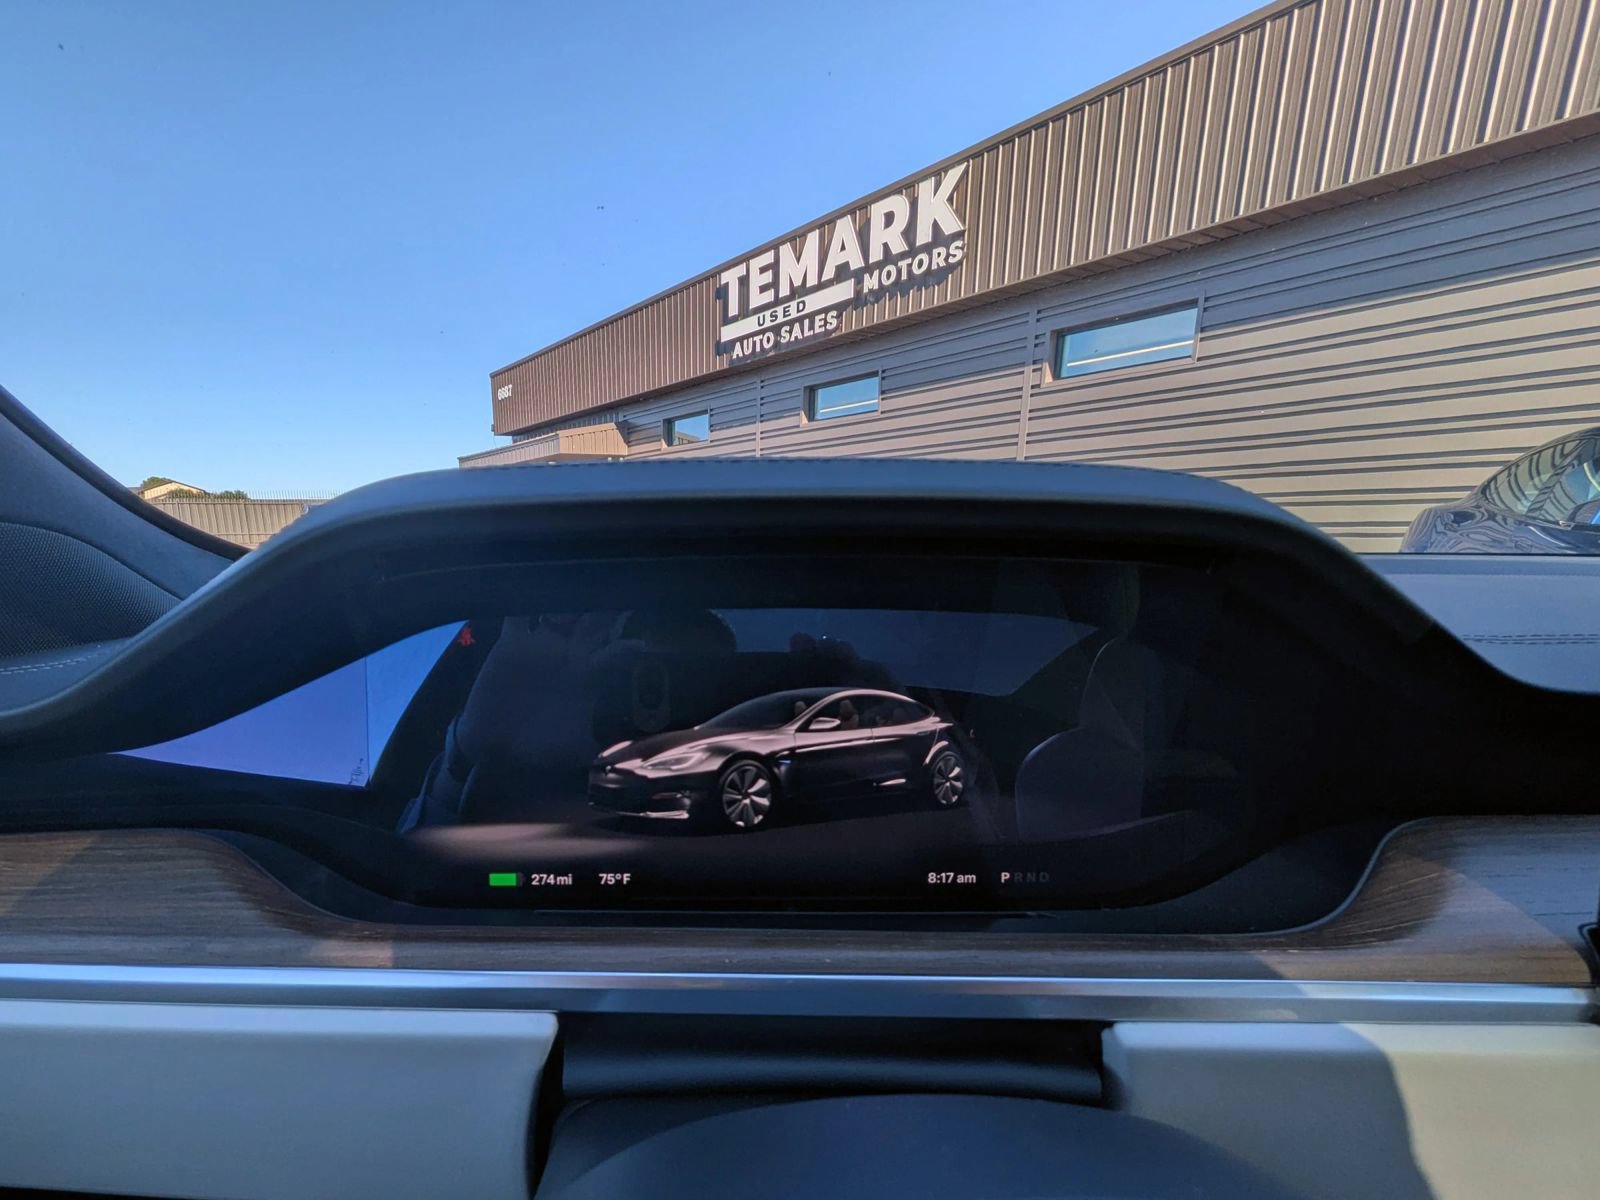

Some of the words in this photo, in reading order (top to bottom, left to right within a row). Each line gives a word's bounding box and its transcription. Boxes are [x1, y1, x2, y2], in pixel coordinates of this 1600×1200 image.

[720, 161, 968, 319] TEMARK
[863, 239, 968, 293] MOTORS
[757, 299, 807, 328] USED
[732, 331, 775, 359] AUTO
[780, 310, 838, 344] SALES
[598, 873, 632, 886] 75°F
[927, 872, 955, 884] 8:17
[956, 875, 977, 884] am
